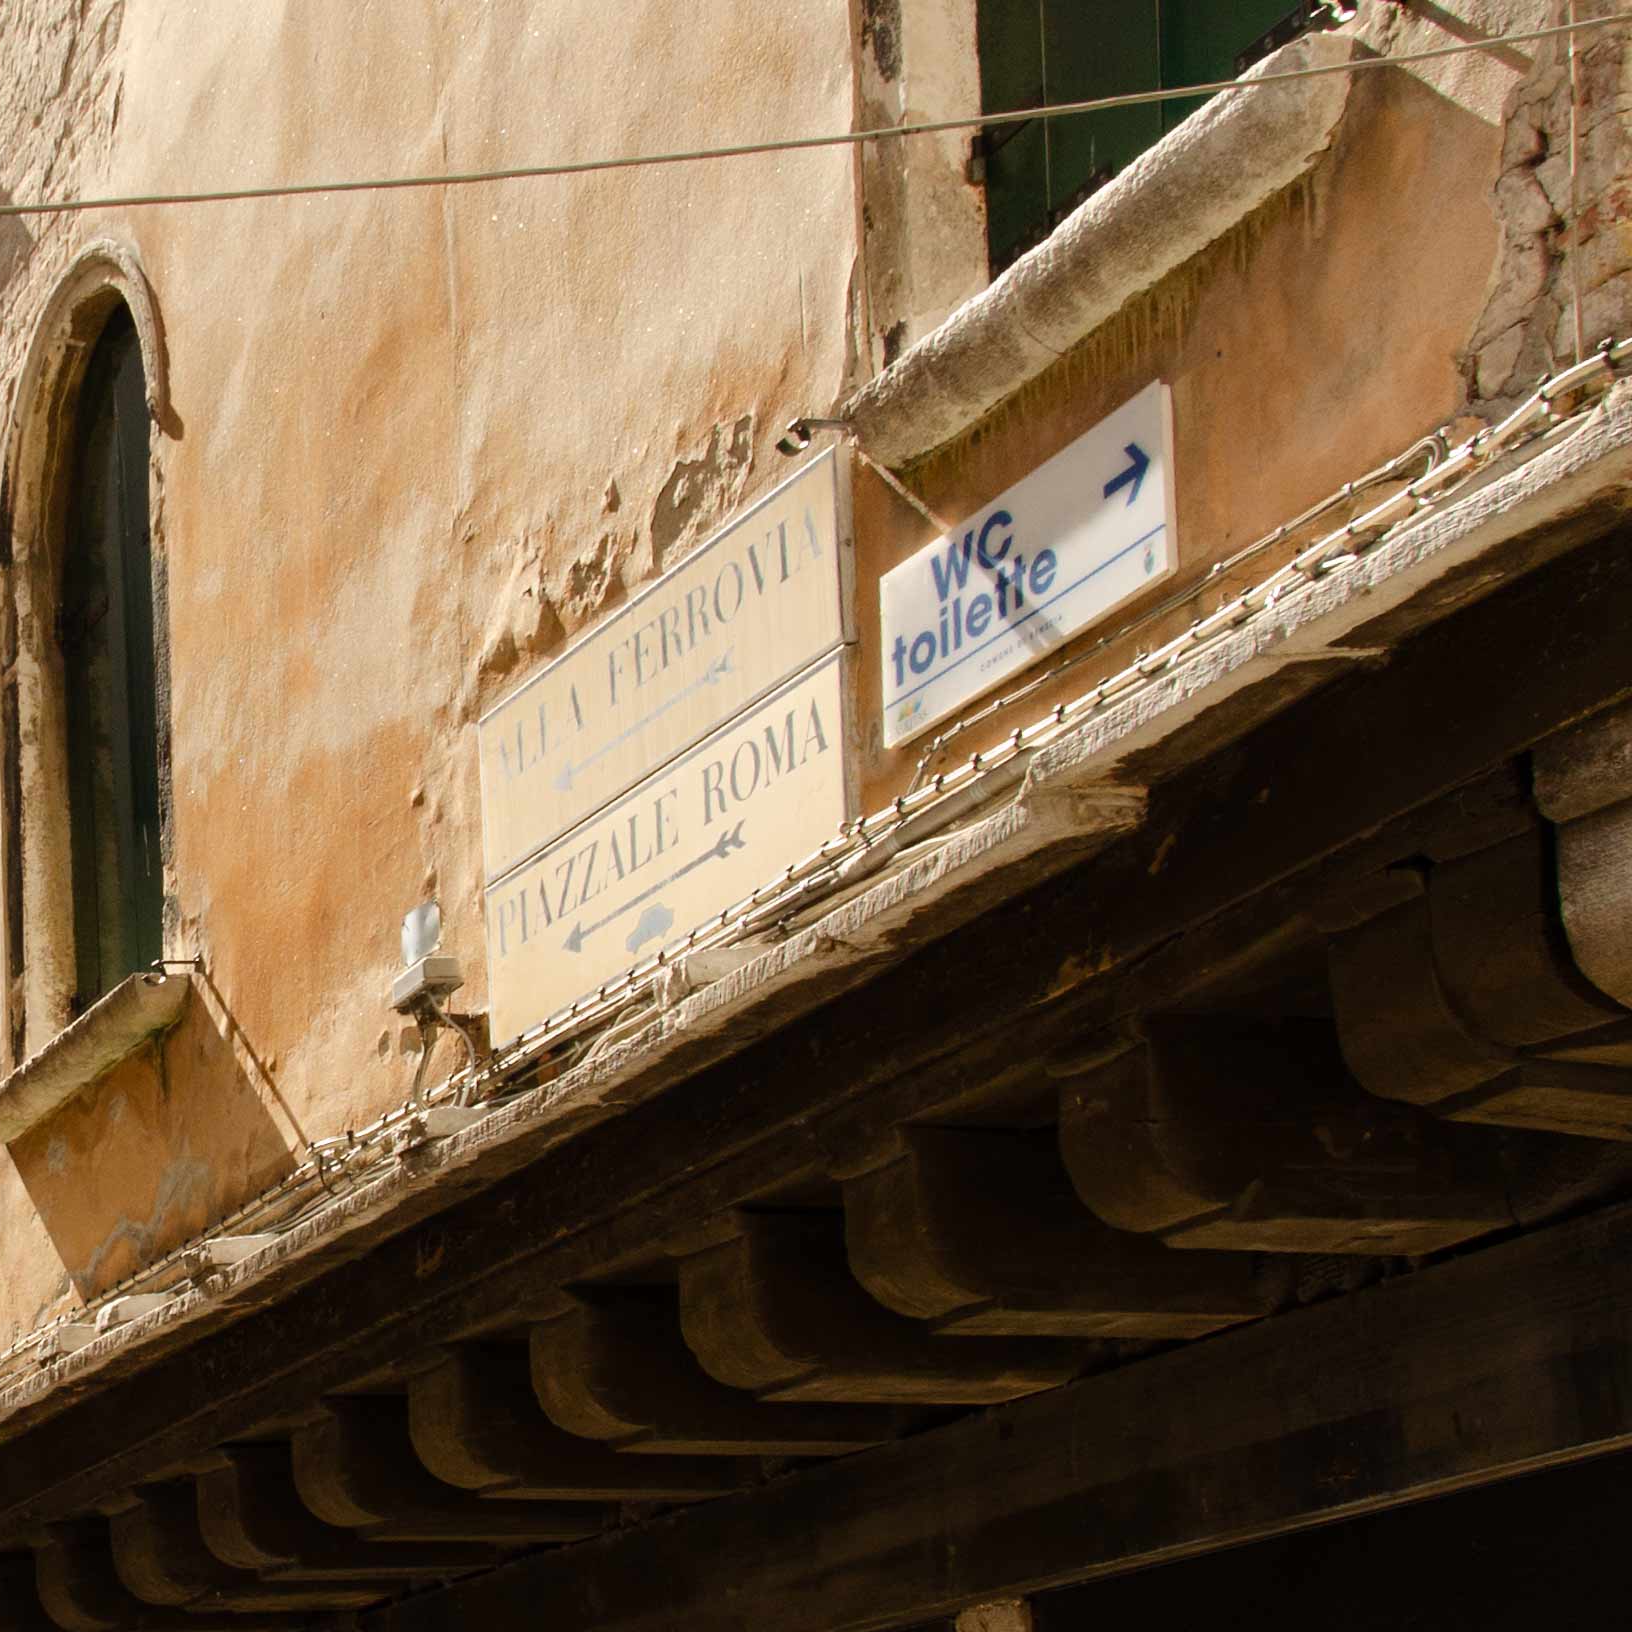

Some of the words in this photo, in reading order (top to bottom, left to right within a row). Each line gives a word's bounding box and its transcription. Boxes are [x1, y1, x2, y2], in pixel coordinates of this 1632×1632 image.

[606, 503, 825, 692] FERROVIA
[890, 547, 1058, 688] toilette
[930, 510, 1013, 600] WC
[494, 787, 680, 957] PIAZZALE
[702, 697, 828, 826] ROMA
